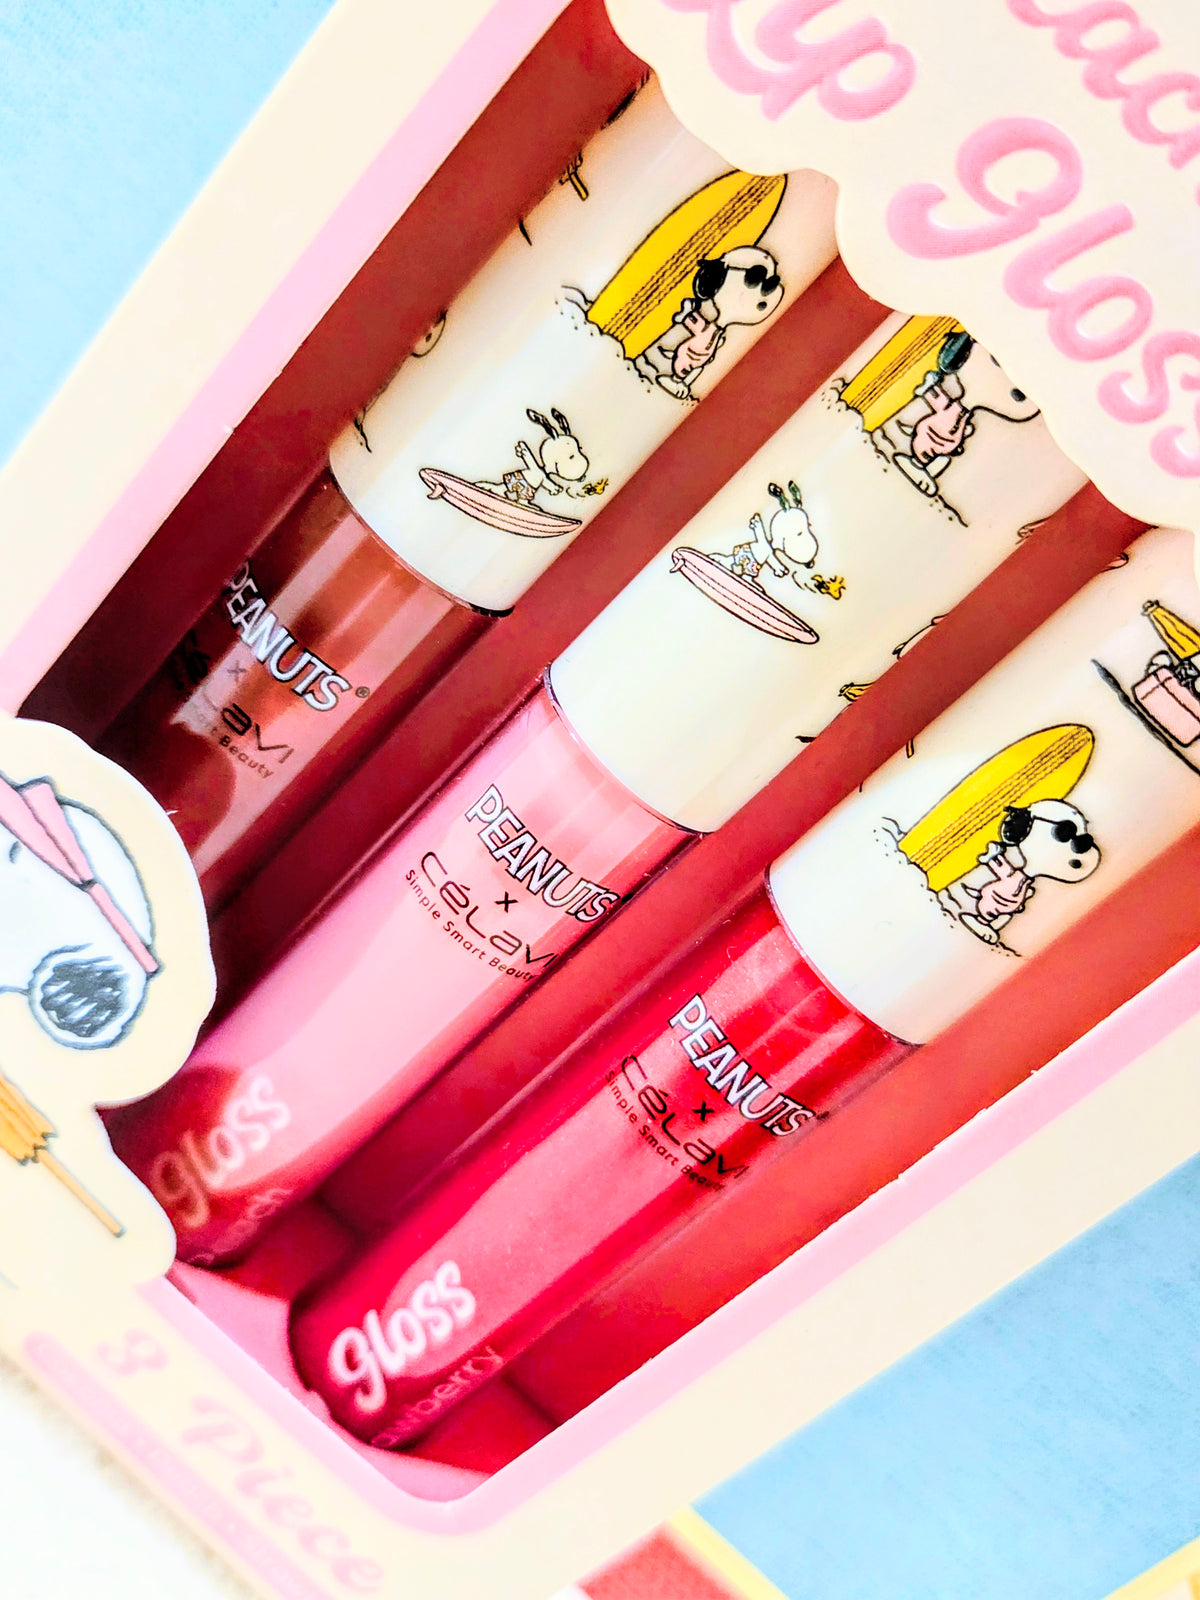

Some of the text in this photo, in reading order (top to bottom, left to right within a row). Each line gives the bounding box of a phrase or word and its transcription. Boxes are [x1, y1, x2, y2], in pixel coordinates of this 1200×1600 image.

[221, 557, 353, 713] PEANUTS
[405, 869, 536, 982] Simple Smart Beauty
[465, 783, 621, 922] PEANUTS
[605, 1069, 638, 1124] Simple
[638, 1124, 680, 1166] Smart
[667, 992, 816, 1137] PEANUTS
[151, 1074, 292, 1228] gloss
[327, 1259, 476, 1414] gloss
[180, 1394, 385, 1594] Piece
